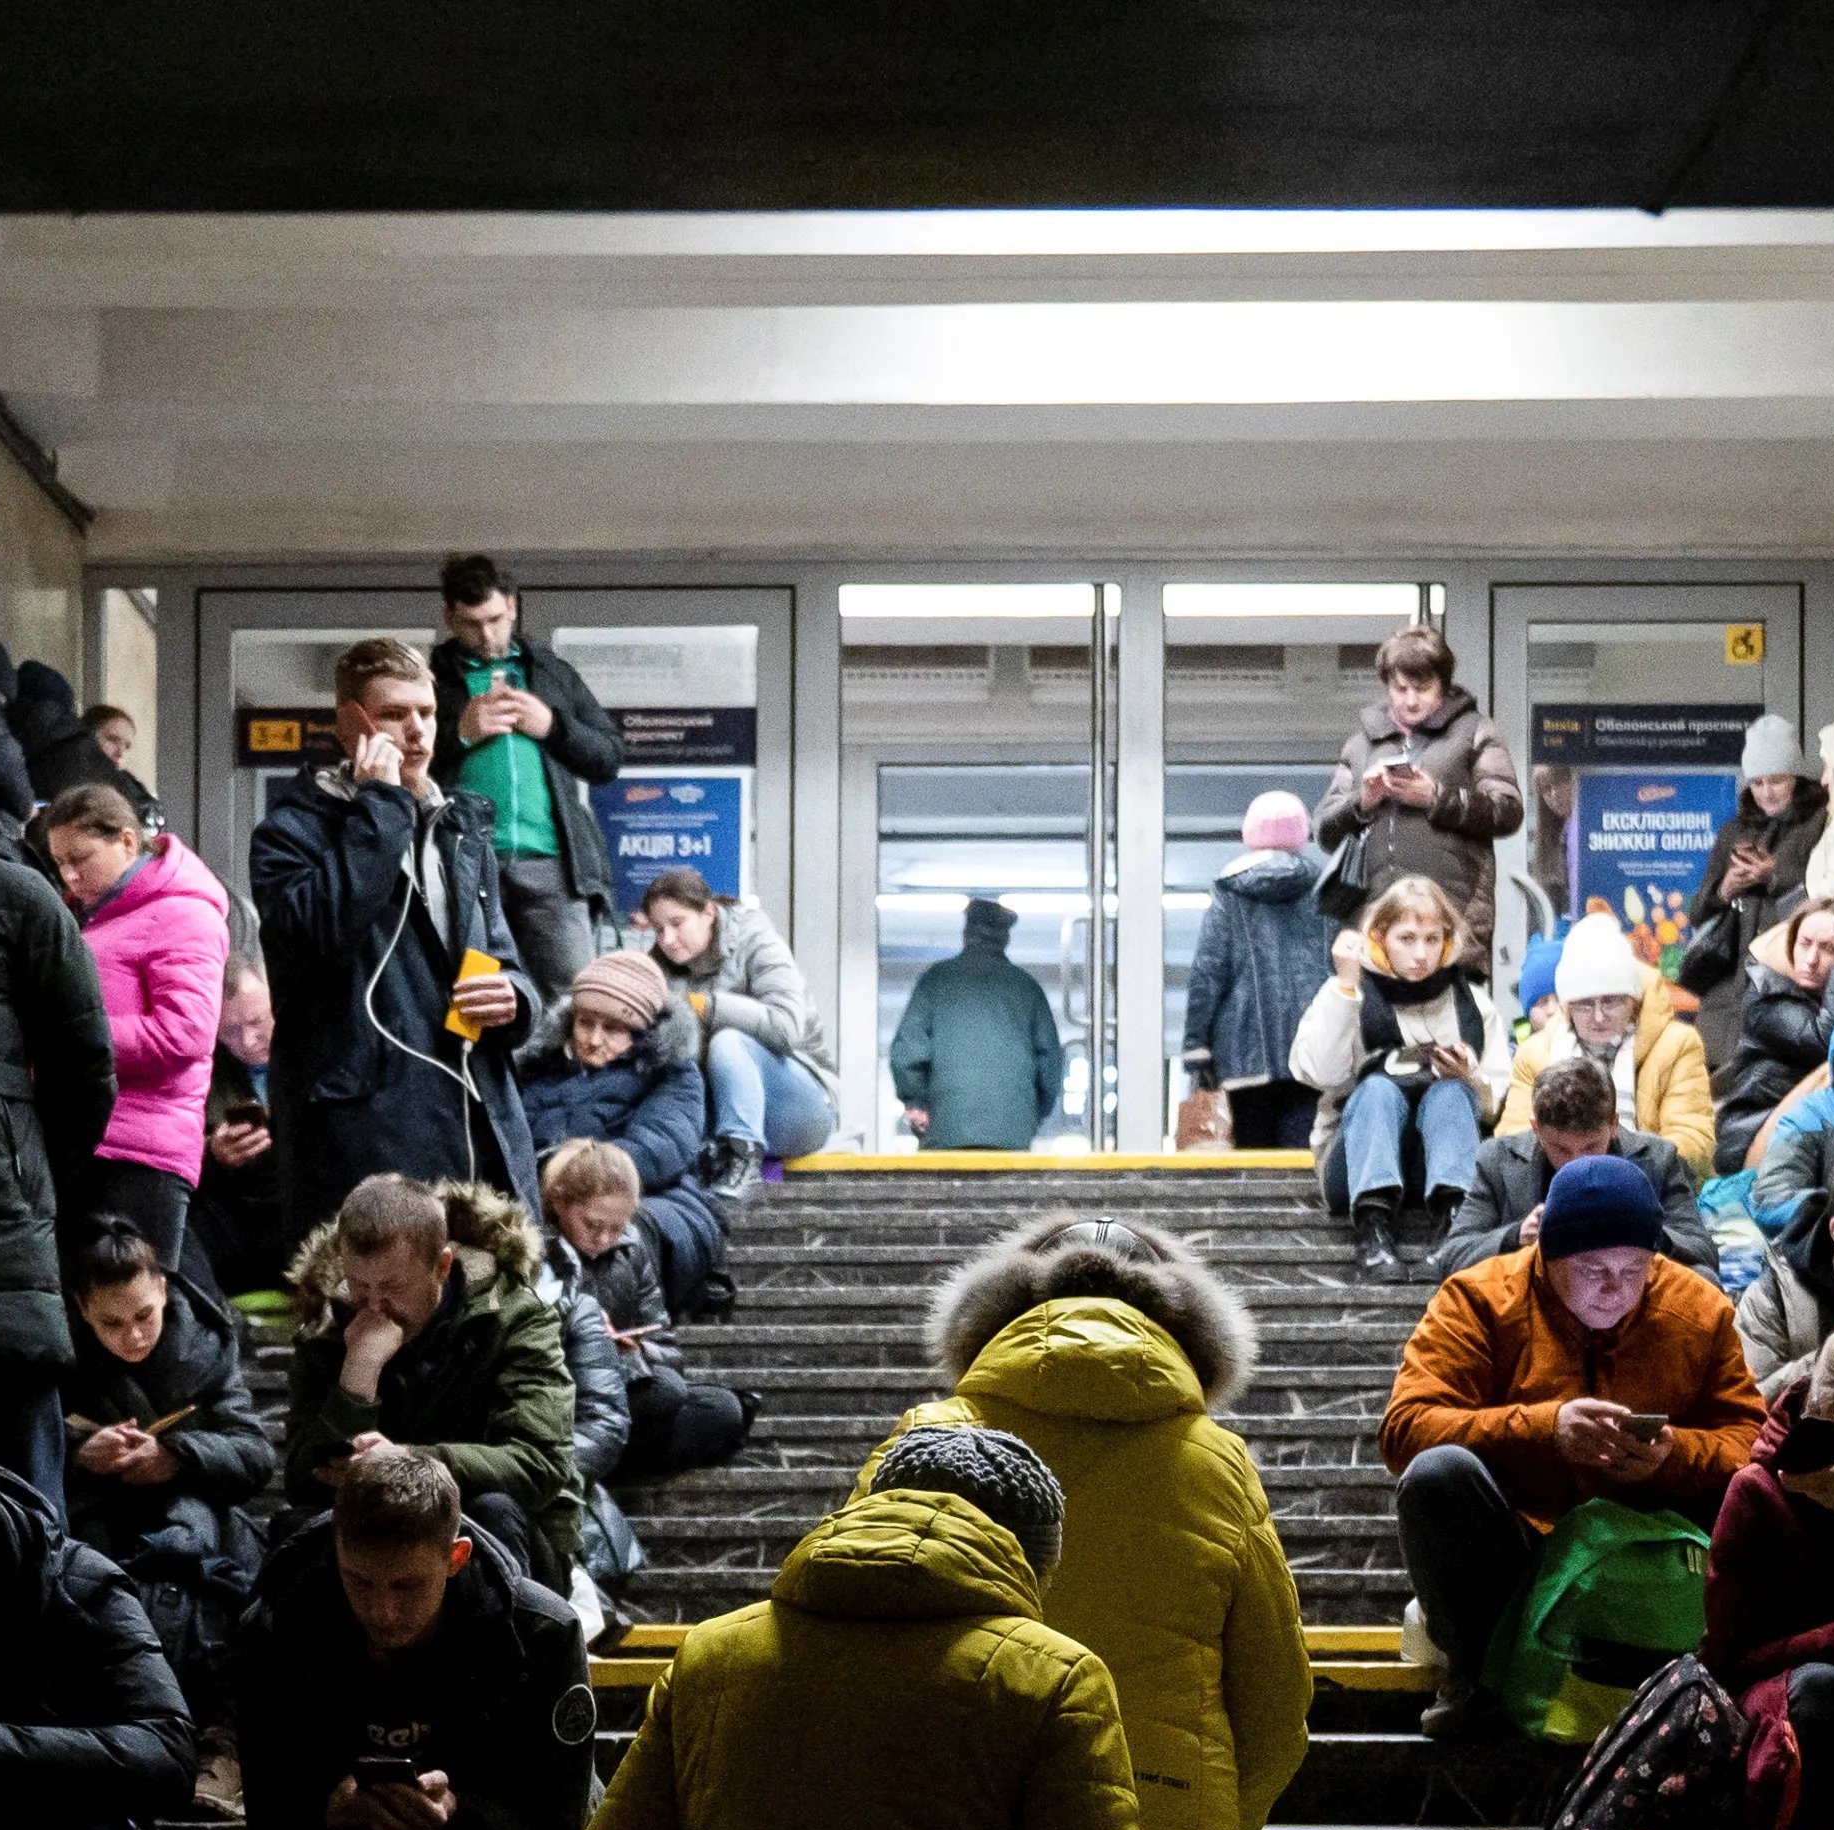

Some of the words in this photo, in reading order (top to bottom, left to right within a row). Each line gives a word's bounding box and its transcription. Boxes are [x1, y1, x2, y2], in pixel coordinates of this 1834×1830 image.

[1594, 717, 1686, 732] Оболонський
[1602, 812, 1712, 830] ЕКСКЛЮЗИВНІ
[618, 835, 675, 858] АКЦІЯ
[678, 834, 712, 857] 3+1
[1588, 832, 1656, 851] ЗНИЖКИ
[1660, 830, 1717, 851] ОНЛАЙ
